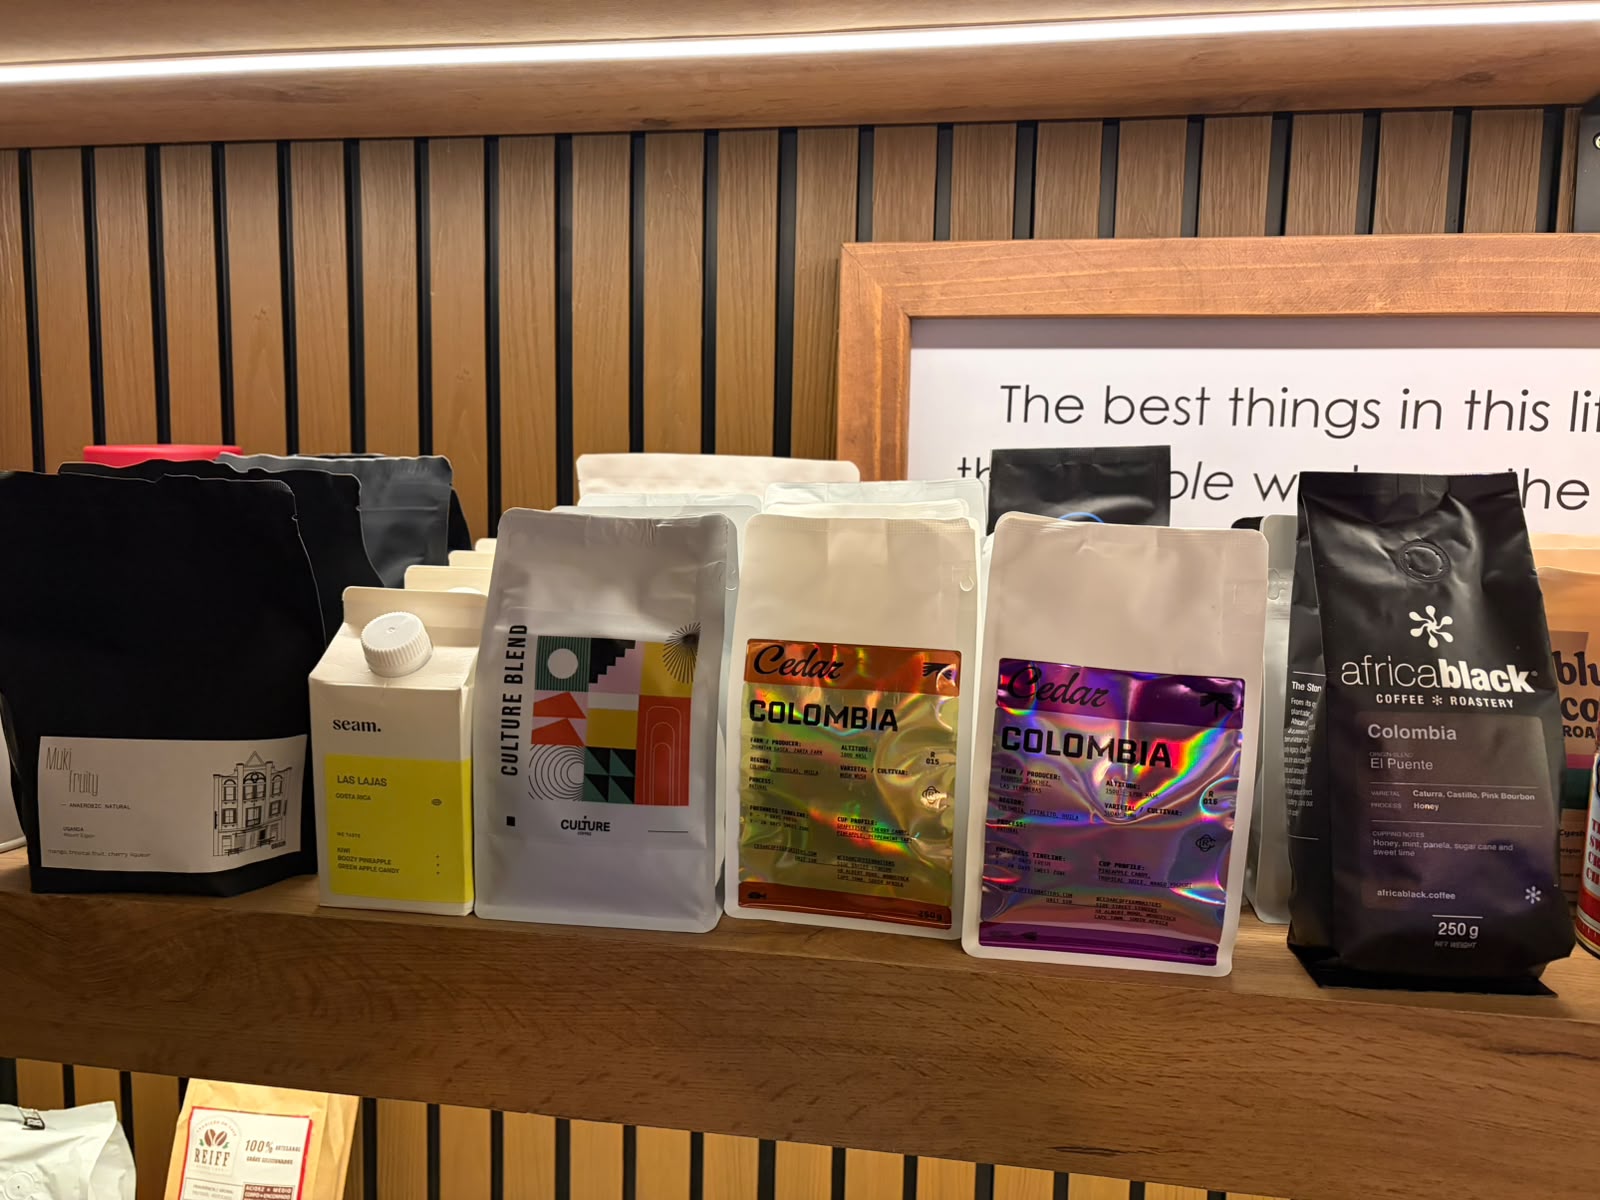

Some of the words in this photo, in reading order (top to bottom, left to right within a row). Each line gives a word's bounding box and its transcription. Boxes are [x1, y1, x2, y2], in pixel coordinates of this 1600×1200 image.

[1000, 385, 1084, 424] The
[1104, 385, 1210, 425] best
[1229, 387, 1381, 439] things
[1400, 388, 1442, 429] in
[1464, 389, 1550, 432] this
[504, 625, 528, 685] BLEND
[754, 645, 844, 680] Cedar
[1341, 655, 1536, 693] africablack
[1007, 666, 1109, 708] Cedar
[1292, 681, 1305, 691] The
[1306, 682, 1322, 693] Stor
[1376, 694, 1425, 705] COFFEE
[1450, 696, 1514, 709] ROASTERY
[750, 700, 898, 732] COLOMBIA
[332, 719, 381, 733] seam.
[1367, 723, 1457, 741] Colombia
[1562, 725, 1596, 739] ROA
[501, 693, 522, 776] CULTURE
[772, 739, 802, 747] PRODUCER:
[841, 744, 872, 753] ALTITUDE:
[1001, 726, 1171, 768] COLOMBIA
[46, 747, 72, 770] Muki
[926, 758, 940, 766] 015
[1370, 757, 1383, 769] El
[1387, 759, 1434, 770] Puente
[840, 765, 867, 773] VARIETAL
[877, 768, 909, 776] CULTIVAR:
[1027, 771, 1061, 780] PRODUCER:
[69, 770, 99, 797] fruity
[337, 775, 355, 785] LAS
[357, 776, 387, 787] LAJAS
[749, 777, 774, 785] PROCESS:
[1106, 780, 1141, 790] ALTITUDE:
[1412, 790, 1446, 799] Caturra,
[1446, 791, 1480, 800] Castillo,
[1500, 793, 1535, 801] Bourbon
[1105, 802, 1136, 812] VARIETAL
[1147, 808, 1183, 816] CULTIVAR:
[1413, 802, 1440, 811] Honey
[561, 817, 611, 832] CULTURE
[1373, 839, 1400, 848] Honey,
[1402, 841, 1422, 849] mint,
[1423, 842, 1452, 851] panela,
[1454, 843, 1476, 852] sugar
[1032, 852, 1066, 861] TIMELINE:
[1373, 849, 1397, 857] sweet
[337, 863, 358, 871] GREEN
[359, 857, 392, 865] PINEAPPLE
[1114, 863, 1145, 871] PROFILE:
[1377, 889, 1456, 900] africablack.coffee
[1438, 922, 1466, 936] 250
[1470, 925, 1479, 939] g
[245, 1139, 274, 1154] 100%
[194, 1148, 231, 1168] REIFF
